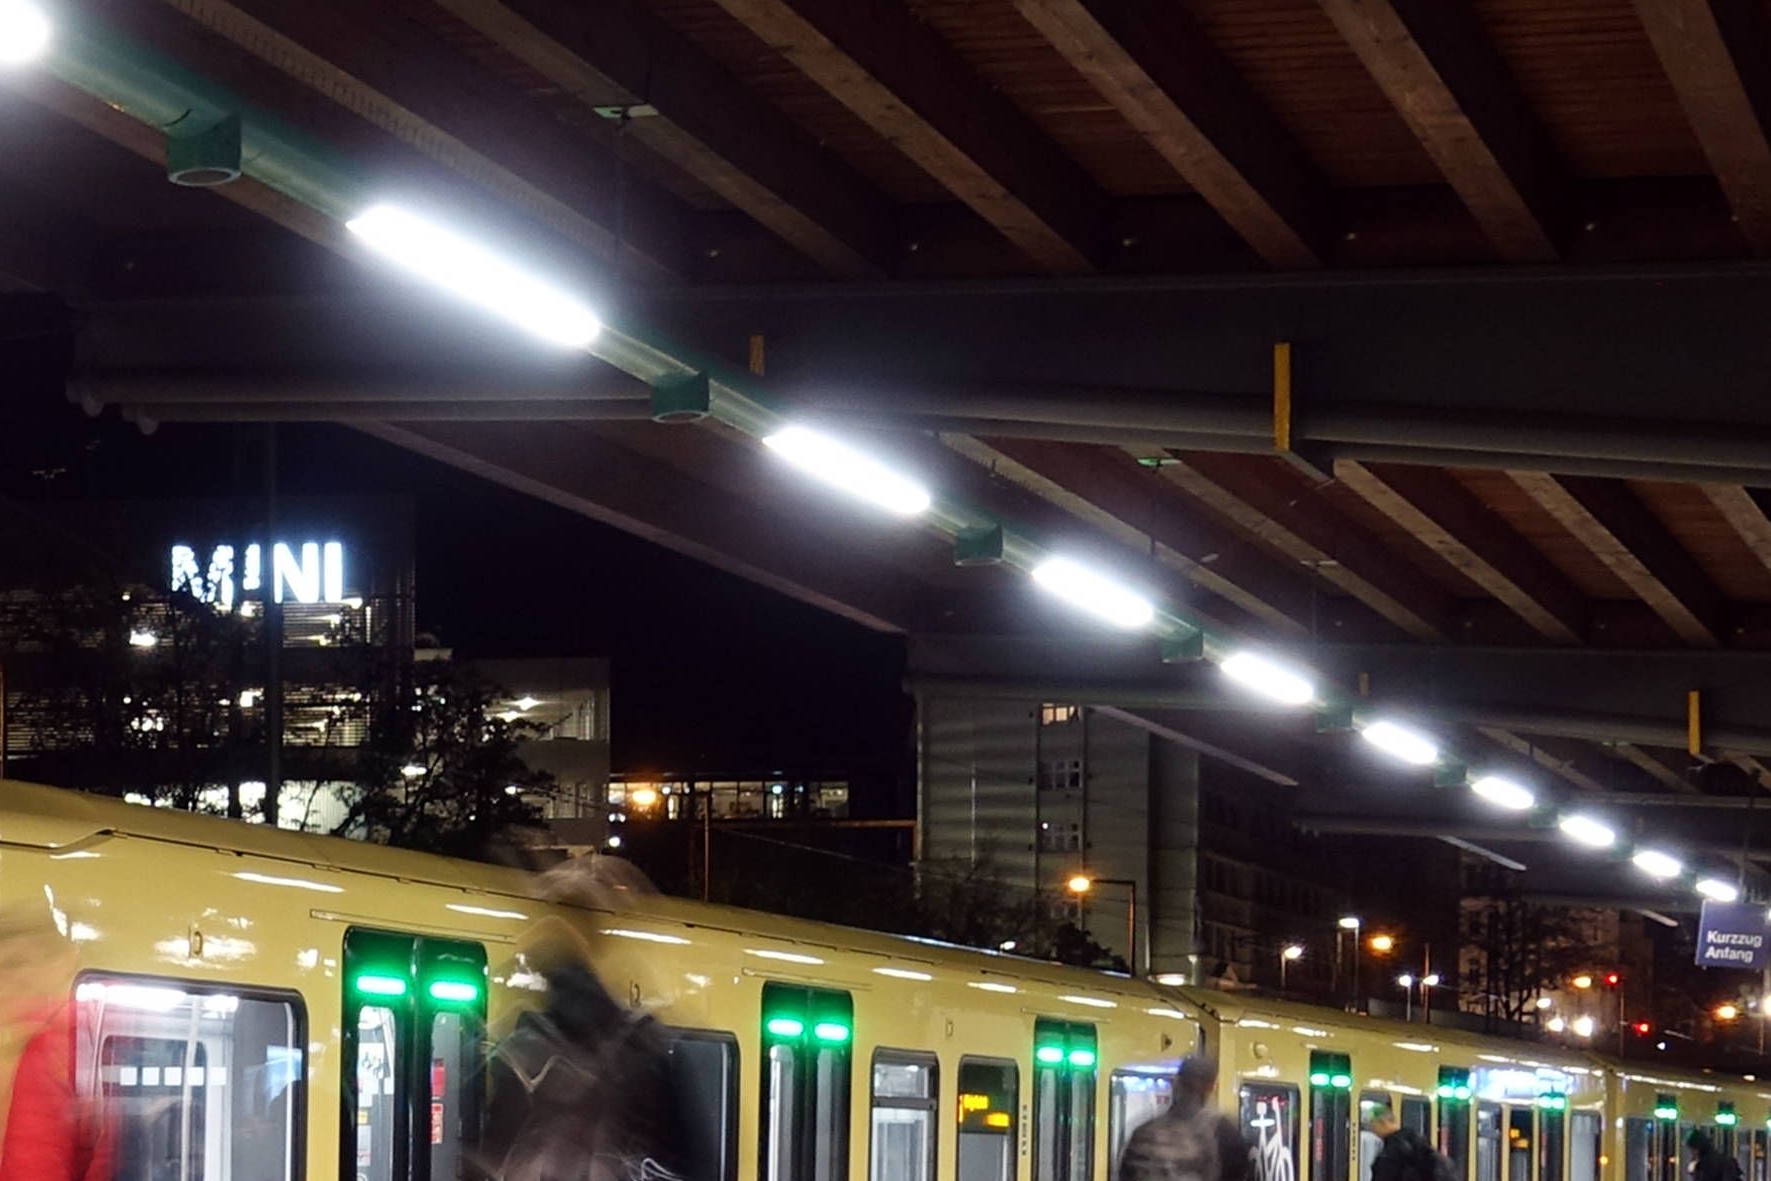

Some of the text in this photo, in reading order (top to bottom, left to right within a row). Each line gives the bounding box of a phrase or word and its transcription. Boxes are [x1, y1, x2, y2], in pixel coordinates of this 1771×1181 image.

[171, 542, 343, 611] MINI
[1707, 930, 1762, 948] Kurzzug
[1705, 946, 1753, 963] Anfang
